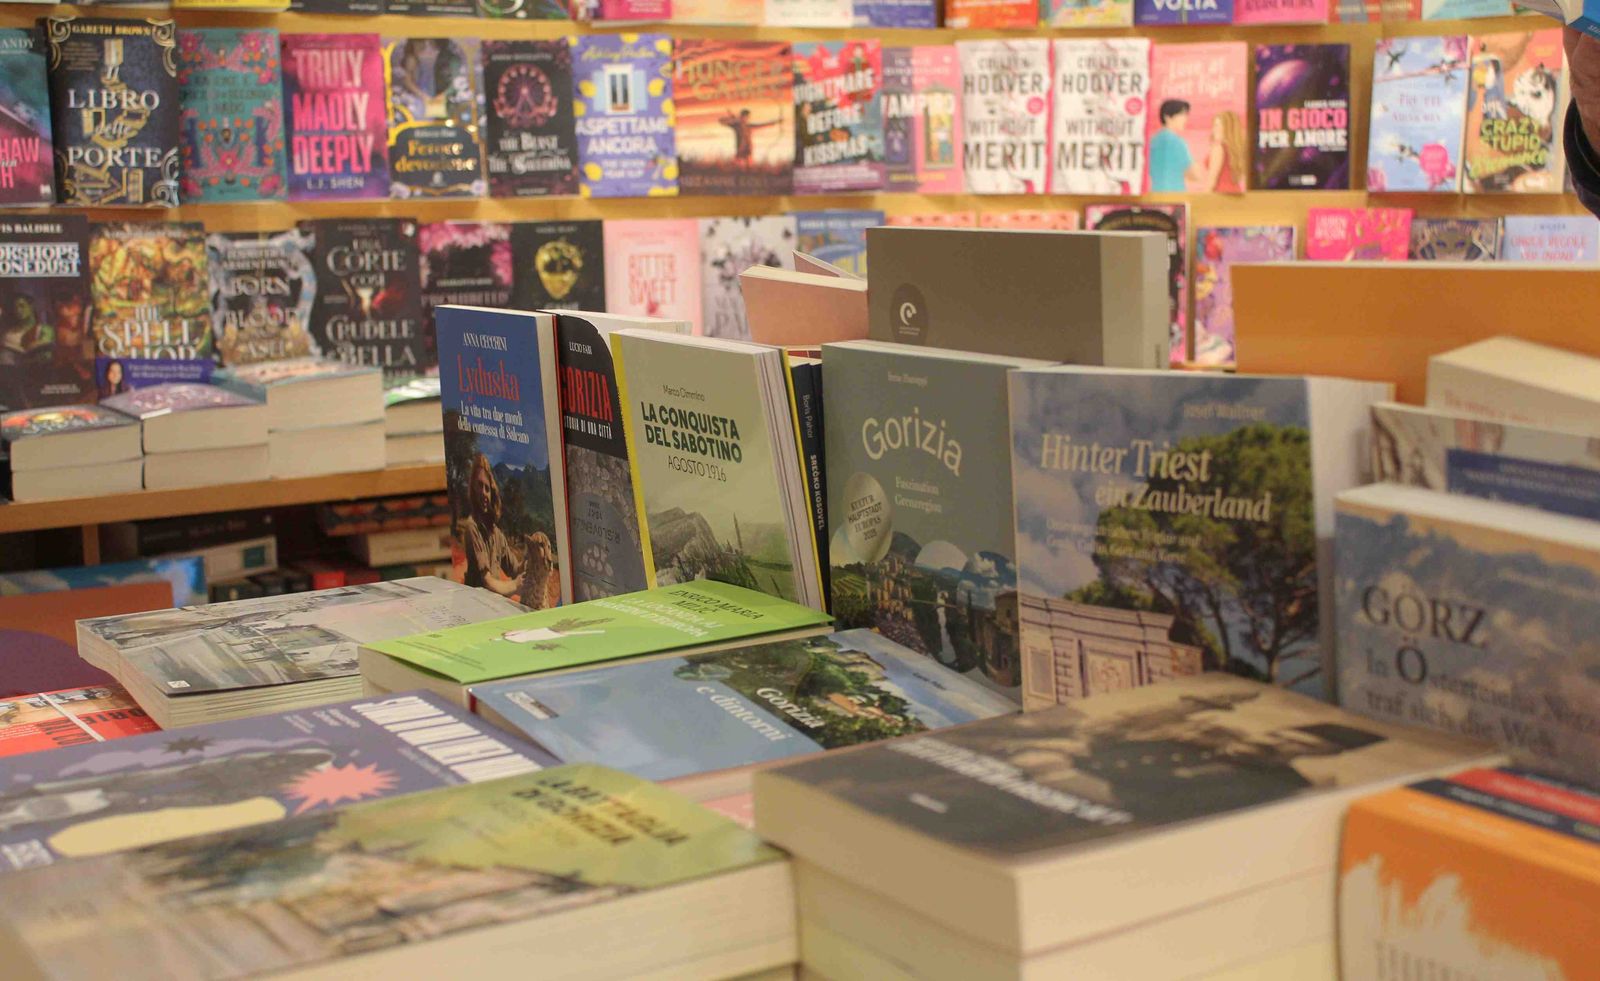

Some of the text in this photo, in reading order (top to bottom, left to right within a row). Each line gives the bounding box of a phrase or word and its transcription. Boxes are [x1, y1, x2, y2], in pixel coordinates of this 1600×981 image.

[291, 47, 364, 88] TRULY
[963, 72, 1043, 95] HOOVER
[1061, 72, 1143, 95] HOOVER
[68, 88, 160, 111] LIBRO
[292, 92, 369, 131] MADLY
[575, 116, 668, 136] ASPETTAMI
[967, 118, 1037, 136] WITHOUT
[1065, 118, 1136, 137] WITHOUT
[1260, 107, 1347, 131] IN GIOCO
[1480, 116, 1541, 136] CRAZY
[586, 136, 658, 156] ANCORA
[1259, 129, 1348, 148] PER AMORE
[68, 146, 162, 168] PORTE
[293, 135, 374, 175] DEEPLY
[962, 141, 1045, 171] MERIT
[1058, 141, 1144, 171] MERIT
[326, 245, 407, 277] CORTE
[325, 314, 415, 345] CRUDELE
[463, 332, 480, 348] ANNA
[560, 365, 614, 422] GORIZIA
[663, 384, 680, 398] Marco
[461, 400, 523, 426] La vita tra due mondi
[640, 401, 740, 441] LA CONQUISTA
[457, 415, 472, 432] della
[472, 420, 499, 439] contessa
[500, 424, 506, 440] di
[587, 419, 598, 437] UNA
[645, 423, 743, 464] DEL SABOTINO
[862, 405, 963, 477] Gorizia
[668, 455, 727, 482] AGOSTO 1916
[1040, 433, 1213, 483] Hinter Triest
[1095, 483, 1272, 523] ein Zauberland
[710, 693, 793, 742] dintorni
[757, 687, 826, 729] Gorizia
